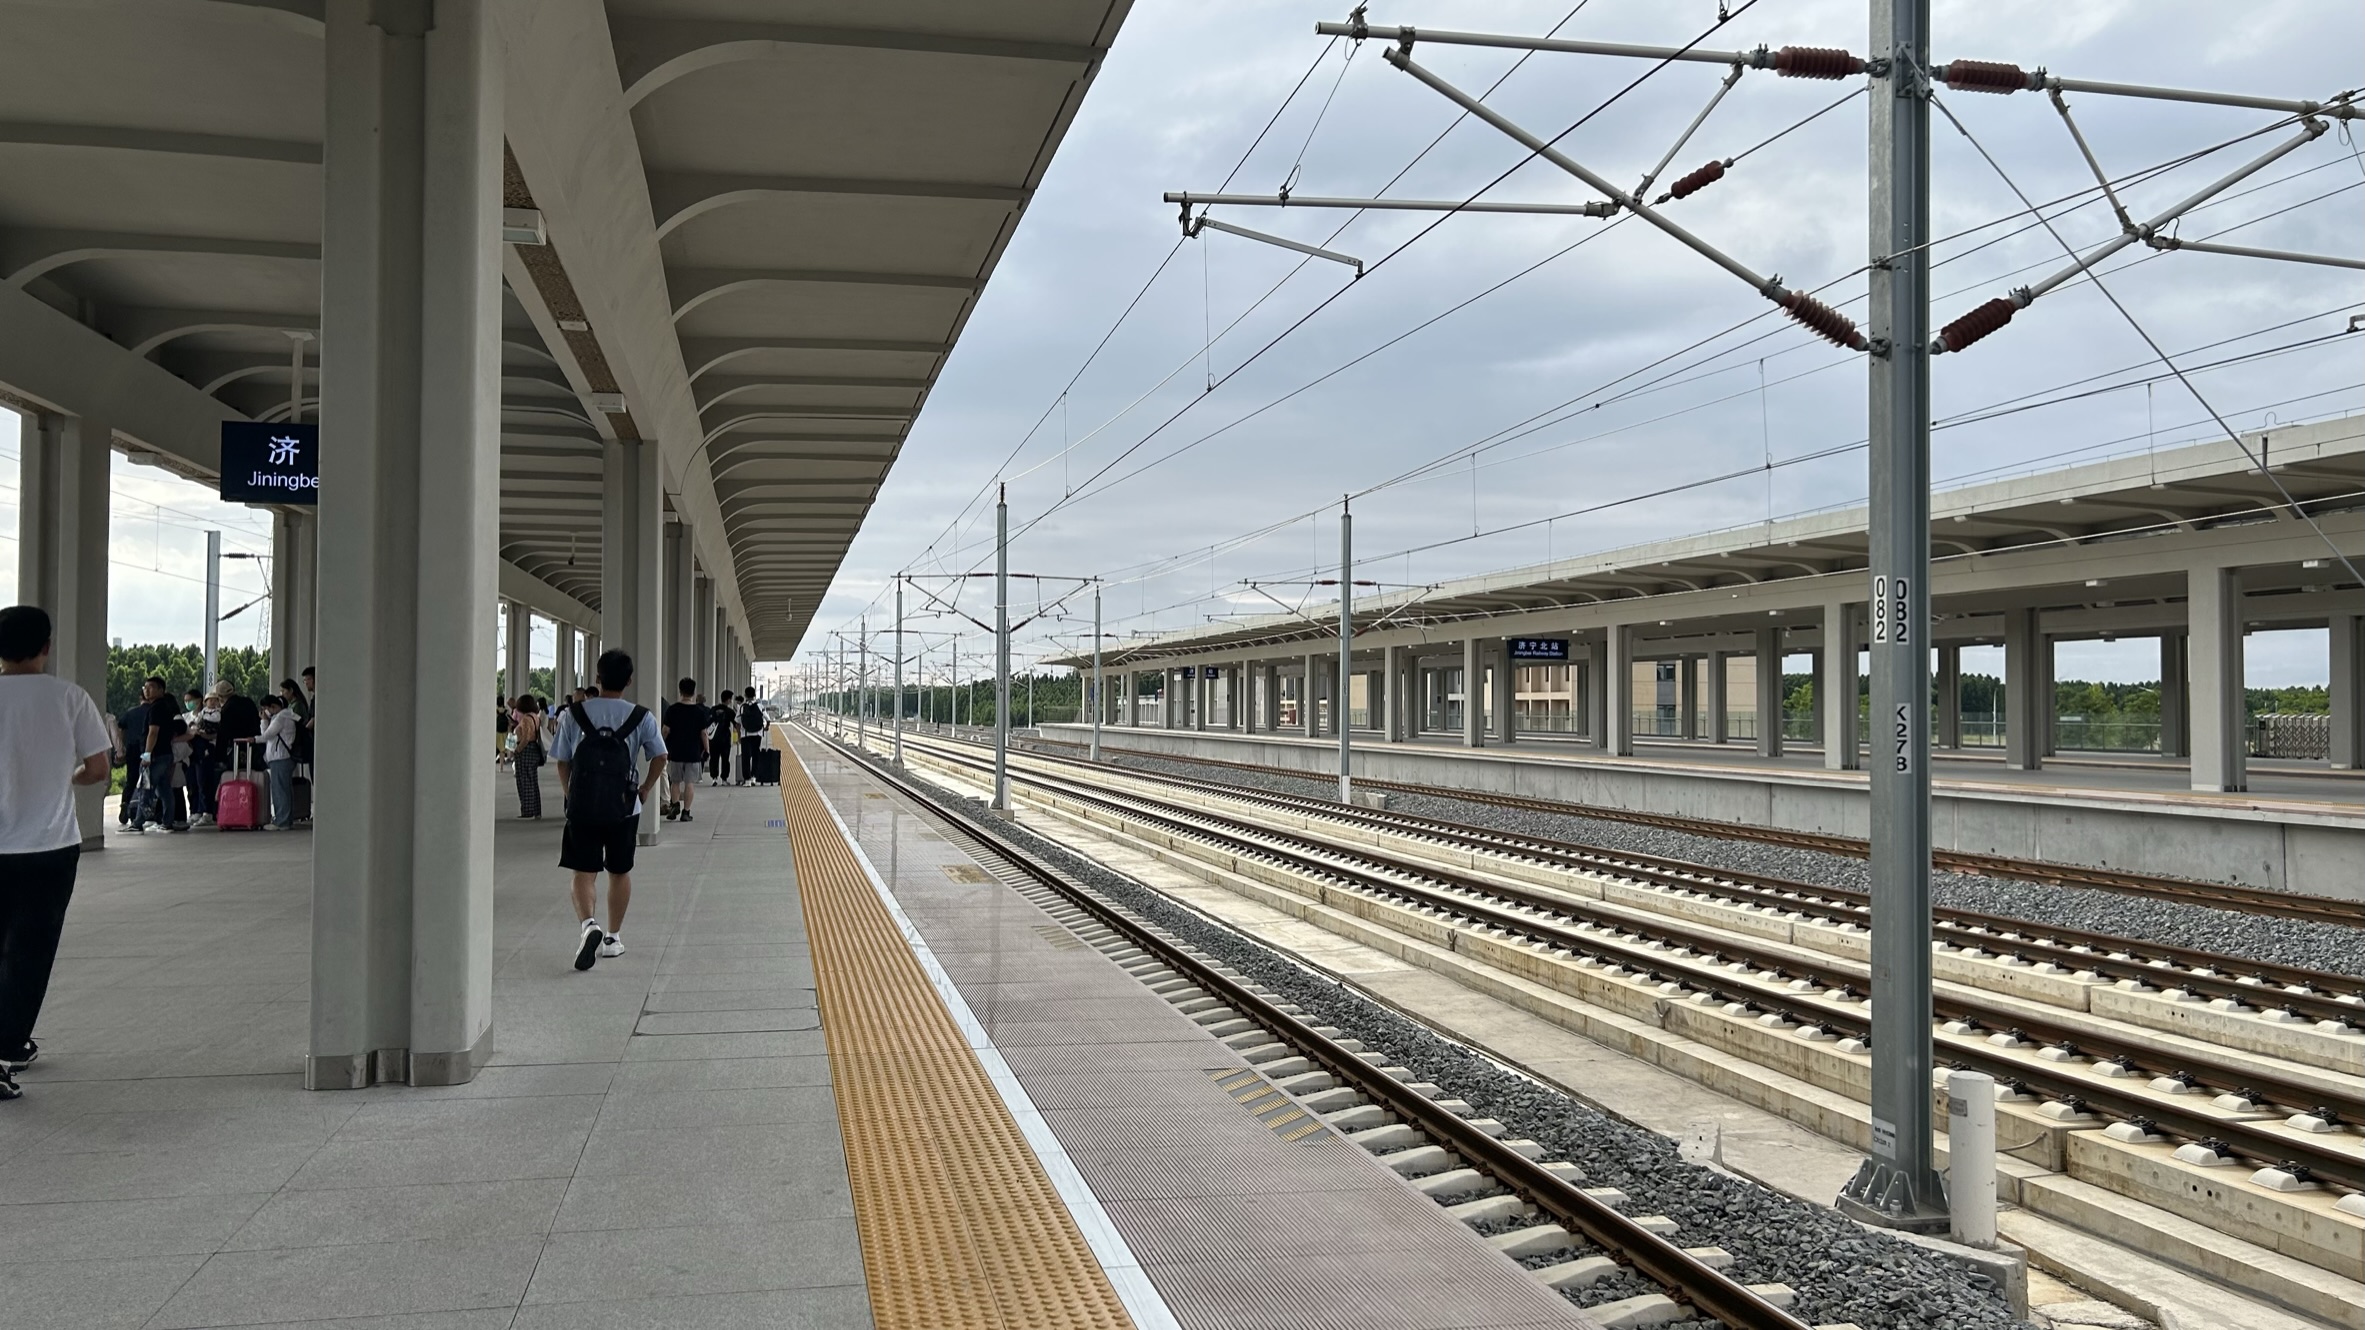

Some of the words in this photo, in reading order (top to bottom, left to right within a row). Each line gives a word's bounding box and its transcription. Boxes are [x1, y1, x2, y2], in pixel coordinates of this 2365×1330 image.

[268, 435, 300, 465] 济
[1876, 577, 1885, 641] 082
[1896, 579, 1907, 642] 082
[1518, 641, 1559, 650] 济宁北站
